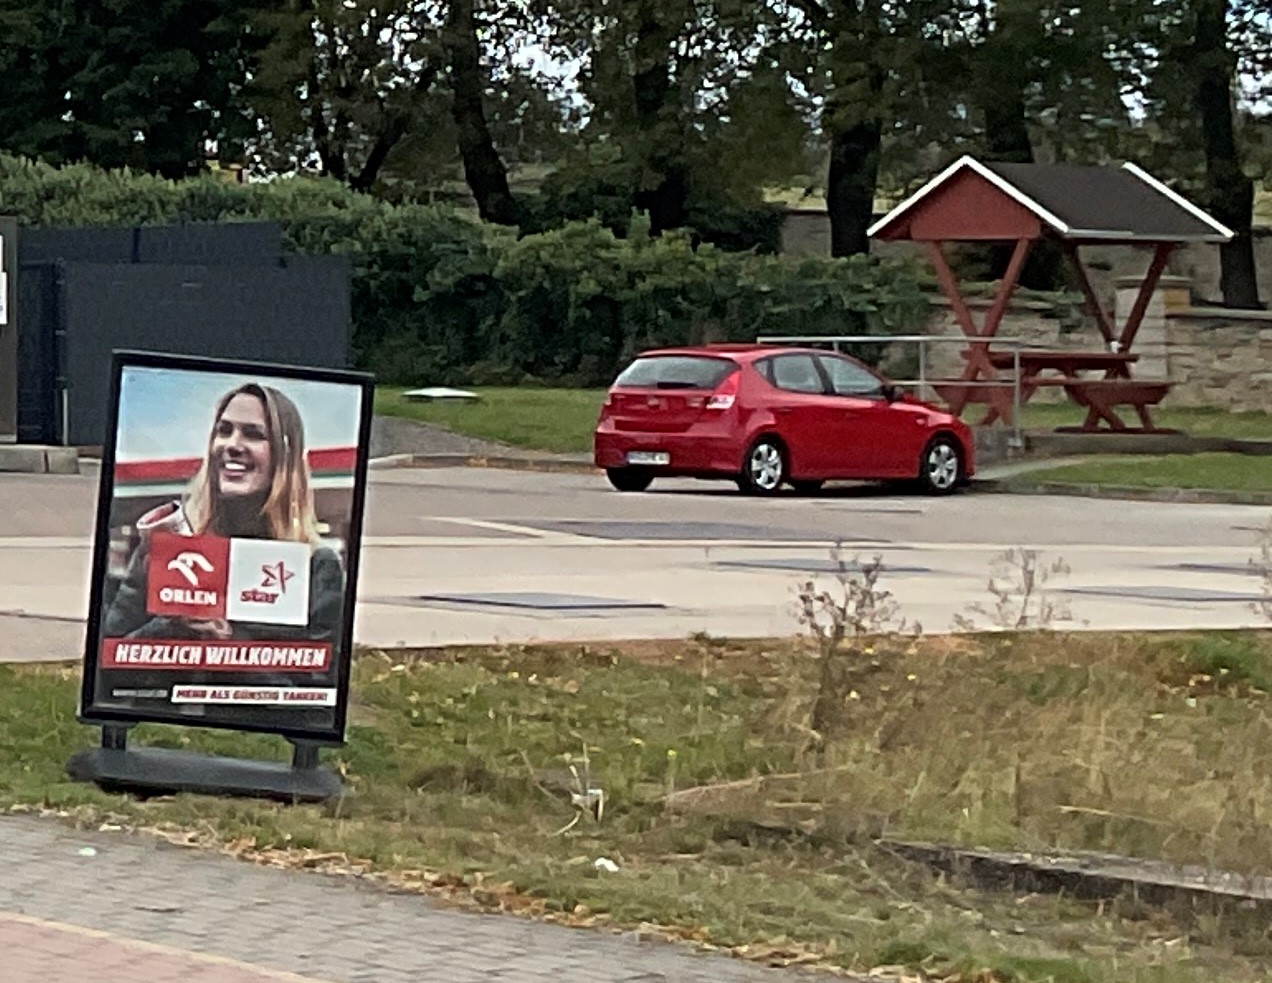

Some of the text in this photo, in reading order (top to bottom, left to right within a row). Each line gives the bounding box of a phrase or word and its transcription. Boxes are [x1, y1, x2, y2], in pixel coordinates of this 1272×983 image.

[159, 587, 217, 605] ORLEN
[240, 589, 279, 603] star
[115, 644, 326, 666] HERZLICH WILLKOMMEN
[210, 689, 230, 700] ALS
